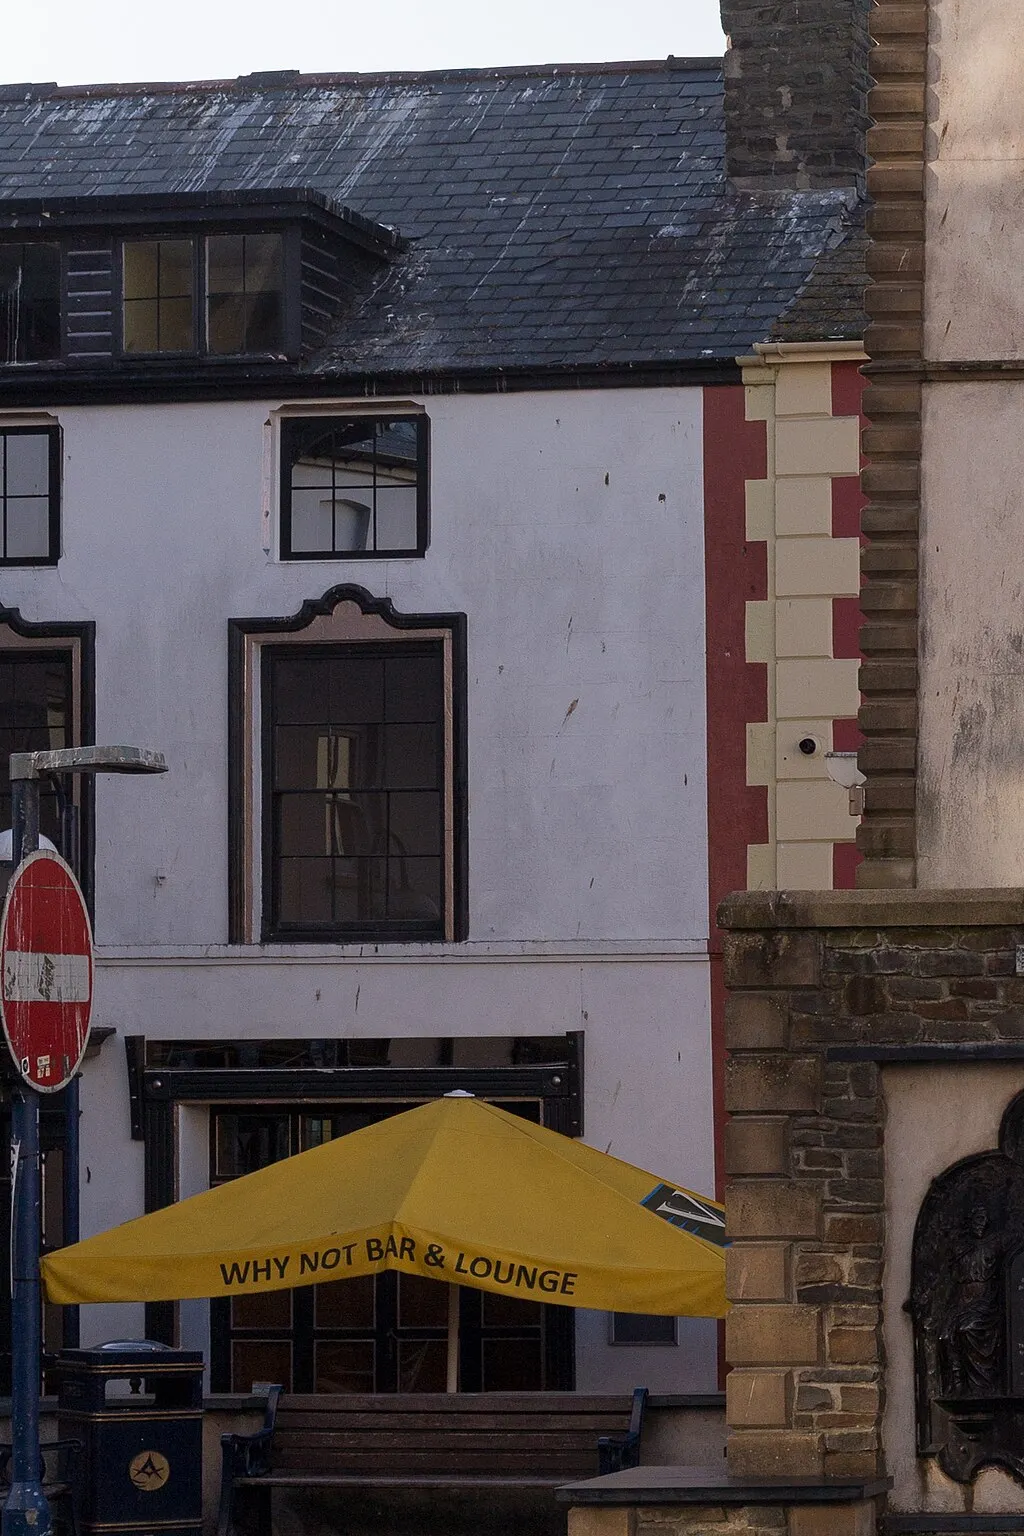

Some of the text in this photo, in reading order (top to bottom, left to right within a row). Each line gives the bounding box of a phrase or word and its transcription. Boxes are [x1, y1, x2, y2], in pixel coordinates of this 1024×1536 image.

[220, 1234, 578, 1295] WHY NOT BAR & LOUNGE
